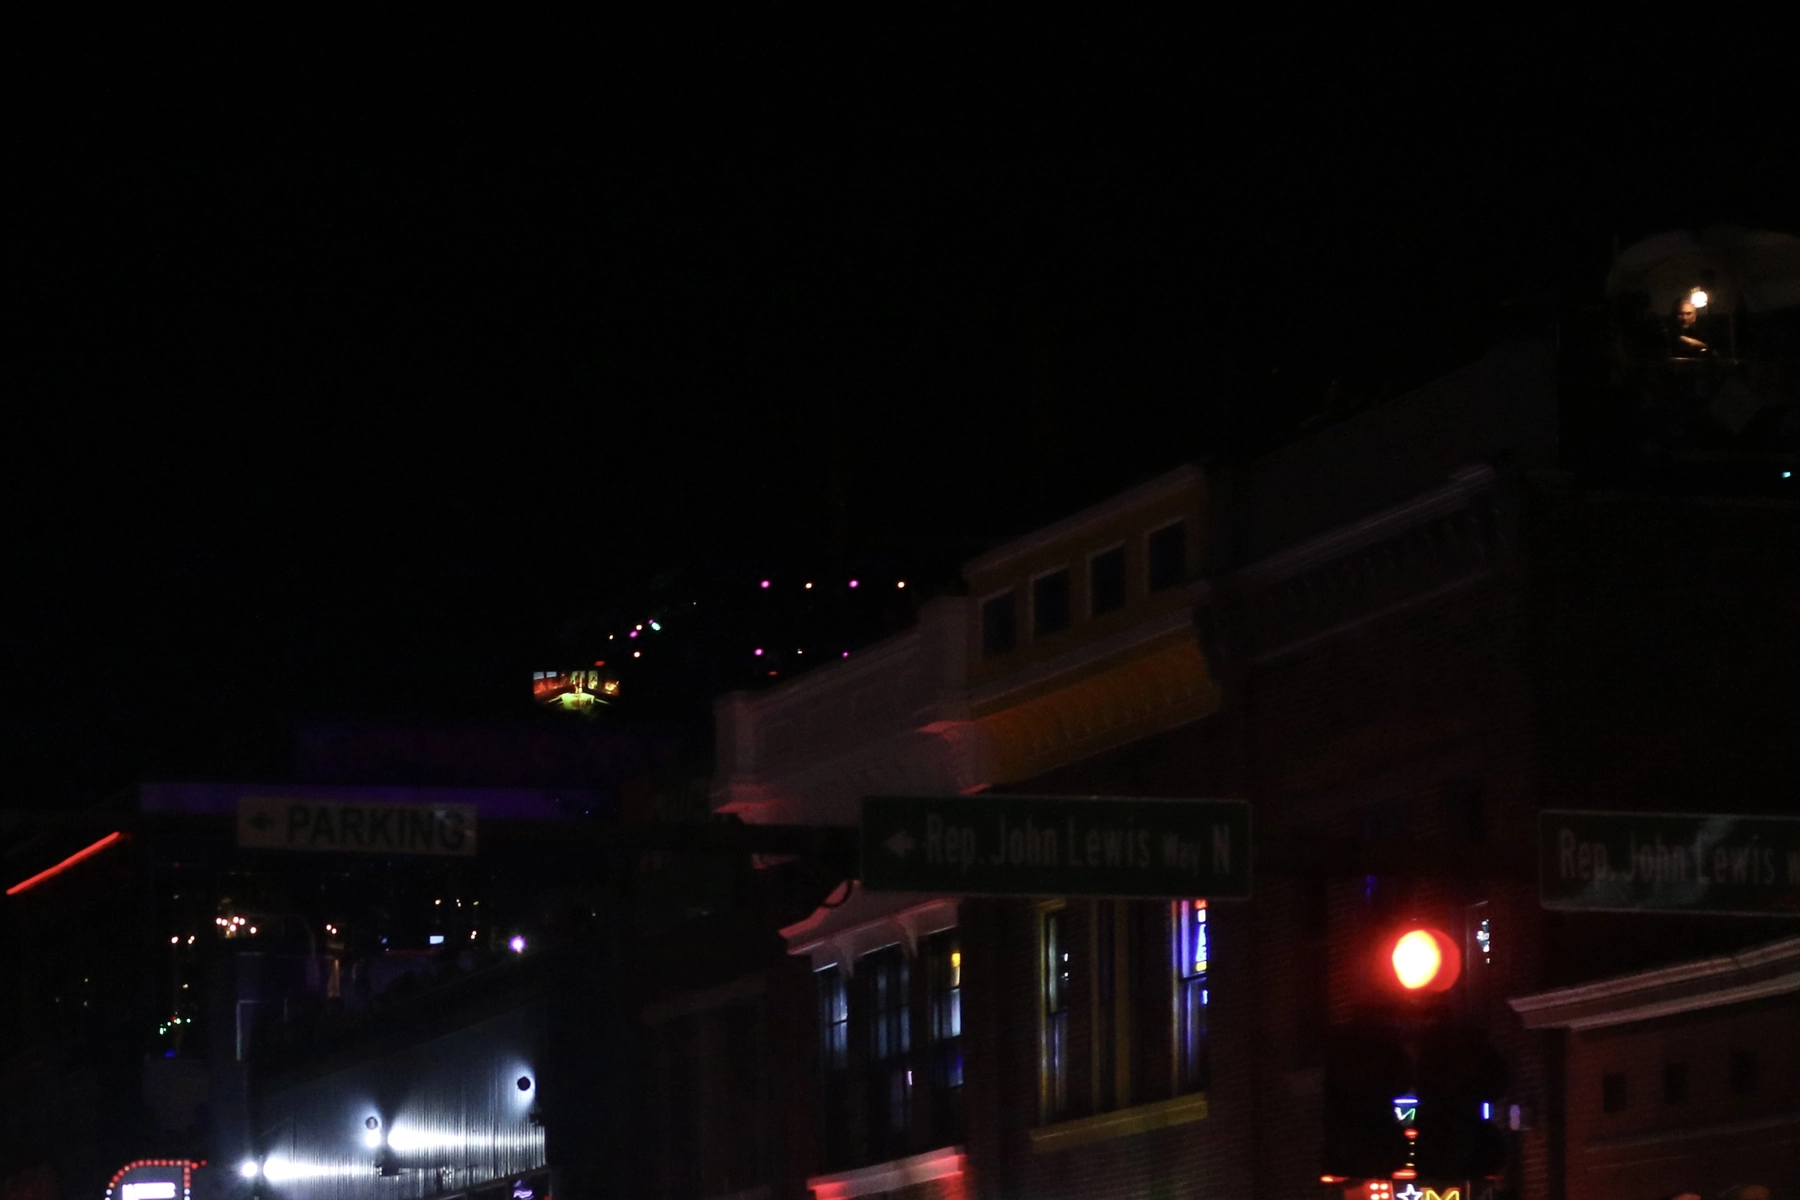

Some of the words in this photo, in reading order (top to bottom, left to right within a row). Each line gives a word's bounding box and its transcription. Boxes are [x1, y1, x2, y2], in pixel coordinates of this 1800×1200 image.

[287, 804, 465, 850] PARKING
[926, 814, 986, 871] Rep.
[991, 815, 1058, 867] John
[1069, 816, 1149, 869] Lewis
[1213, 824, 1231, 873] N
[1558, 828, 1616, 885] Rep.
[1622, 831, 1686, 882] John
[1690, 833, 1775, 885] Lewis
